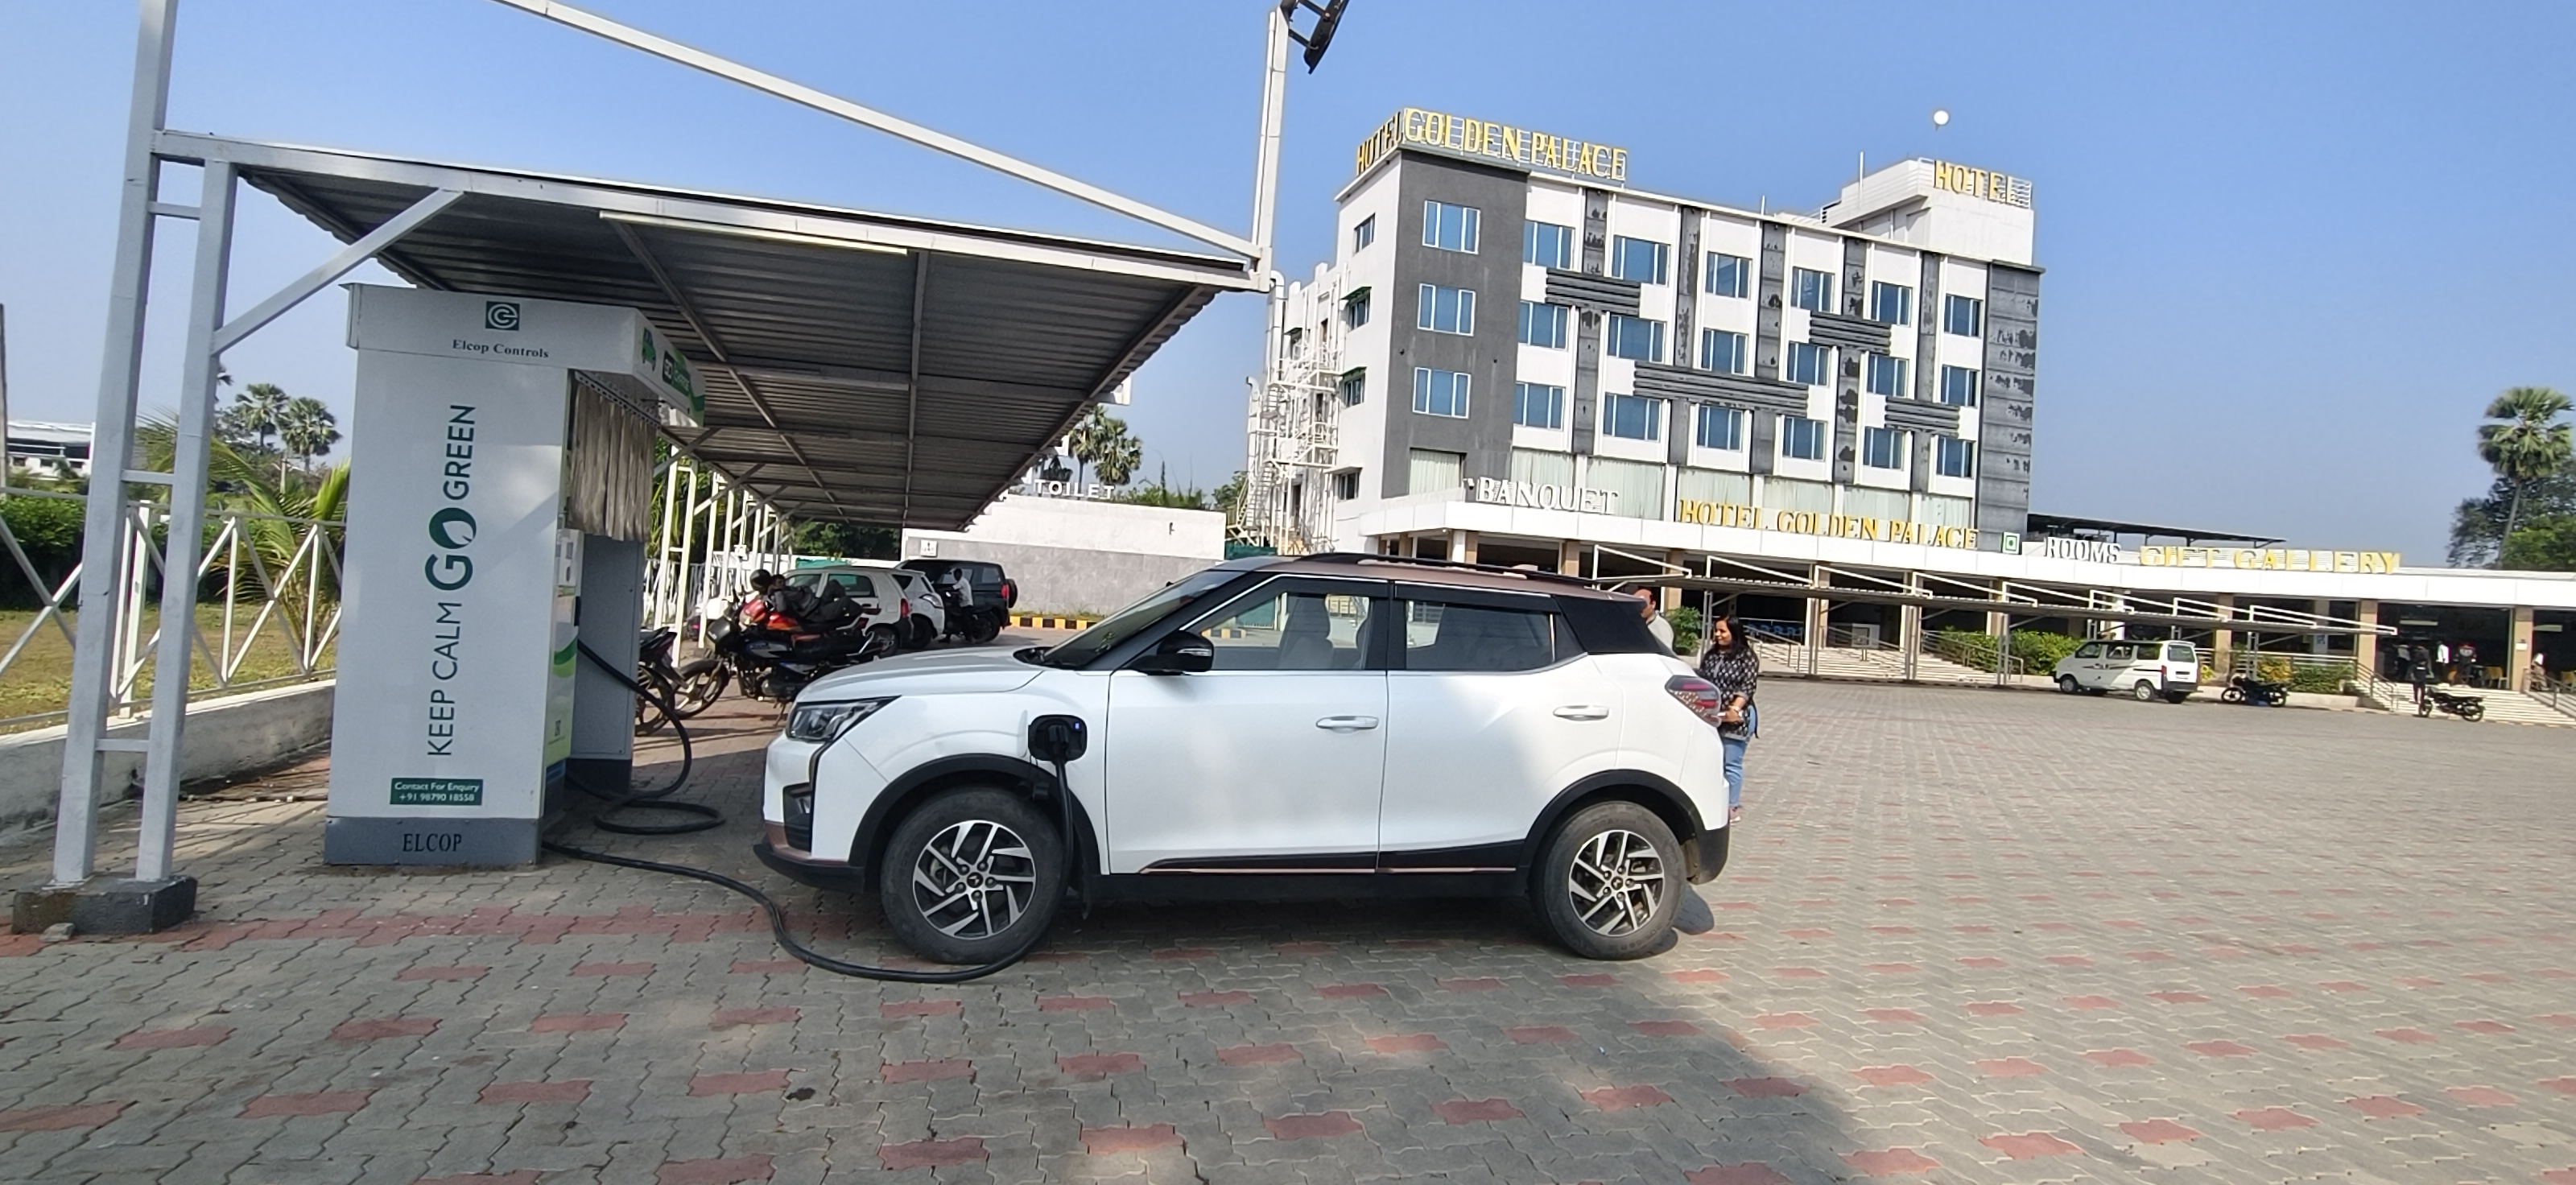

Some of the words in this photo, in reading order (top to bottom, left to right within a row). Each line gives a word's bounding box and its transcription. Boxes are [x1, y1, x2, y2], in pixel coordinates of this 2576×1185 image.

[1405, 107, 1520, 162] GOLDEN
[1530, 131, 1627, 181] PALACE
[1934, 159, 2021, 206] HOTEL
[452, 339, 489, 354] Elcop
[493, 343, 549, 358] Controls
[443, 405, 476, 501] GREEN
[1034, 479, 1115, 499] TOILET
[1476, 477, 1619, 514] BANQUET
[1679, 499, 1776, 531] HOTEL
[1777, 510, 1878, 541] GOLDEN
[1889, 520, 1979, 550] PALACE
[425, 507, 477, 591] GO
[2045, 536, 2121, 564] ROOMS
[2139, 546, 2221, 568] GIFT
[2234, 548, 2401, 574] GALLERY
[432, 602, 462, 680] CALM
[427, 689, 456, 756] KEEP
[394, 782, 429, 791] Contact
[431, 782, 446, 791] For
[448, 782, 480, 793] Enquiry
[399, 793, 417, 802] +91
[420, 793, 447, 802] 98790
[402, 833, 462, 853] ELCOP
